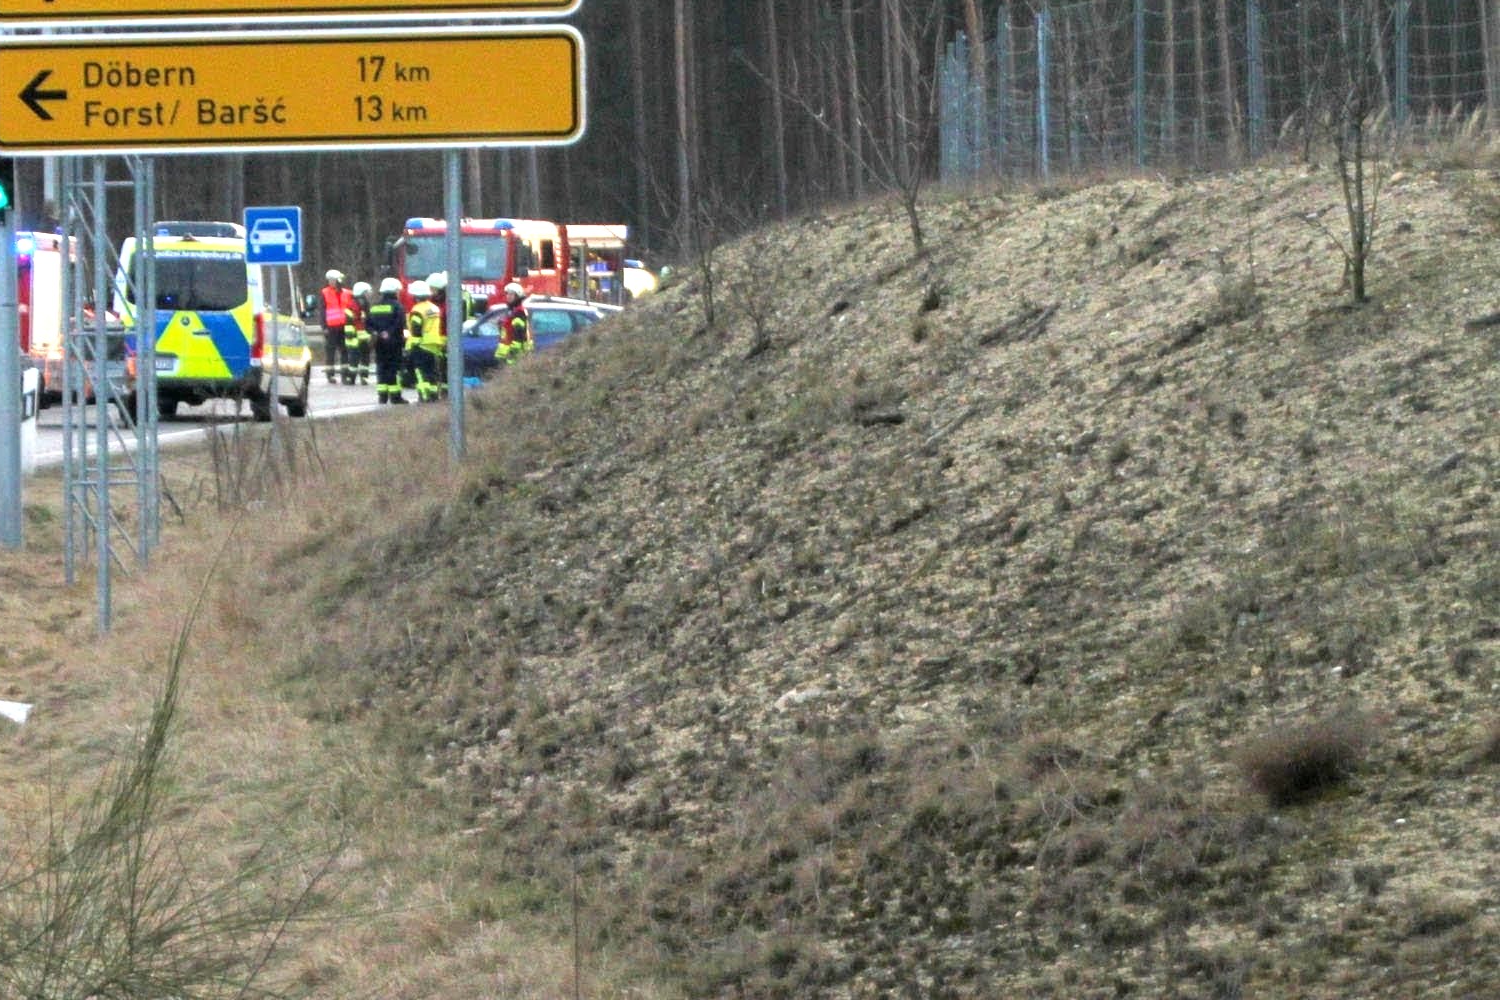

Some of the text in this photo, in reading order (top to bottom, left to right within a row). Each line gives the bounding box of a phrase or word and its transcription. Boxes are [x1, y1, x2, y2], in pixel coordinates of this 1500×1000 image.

[83, 55, 430, 88] Döbern 17 km
[84, 94, 428, 127] Forst/ Baršć 13 km
